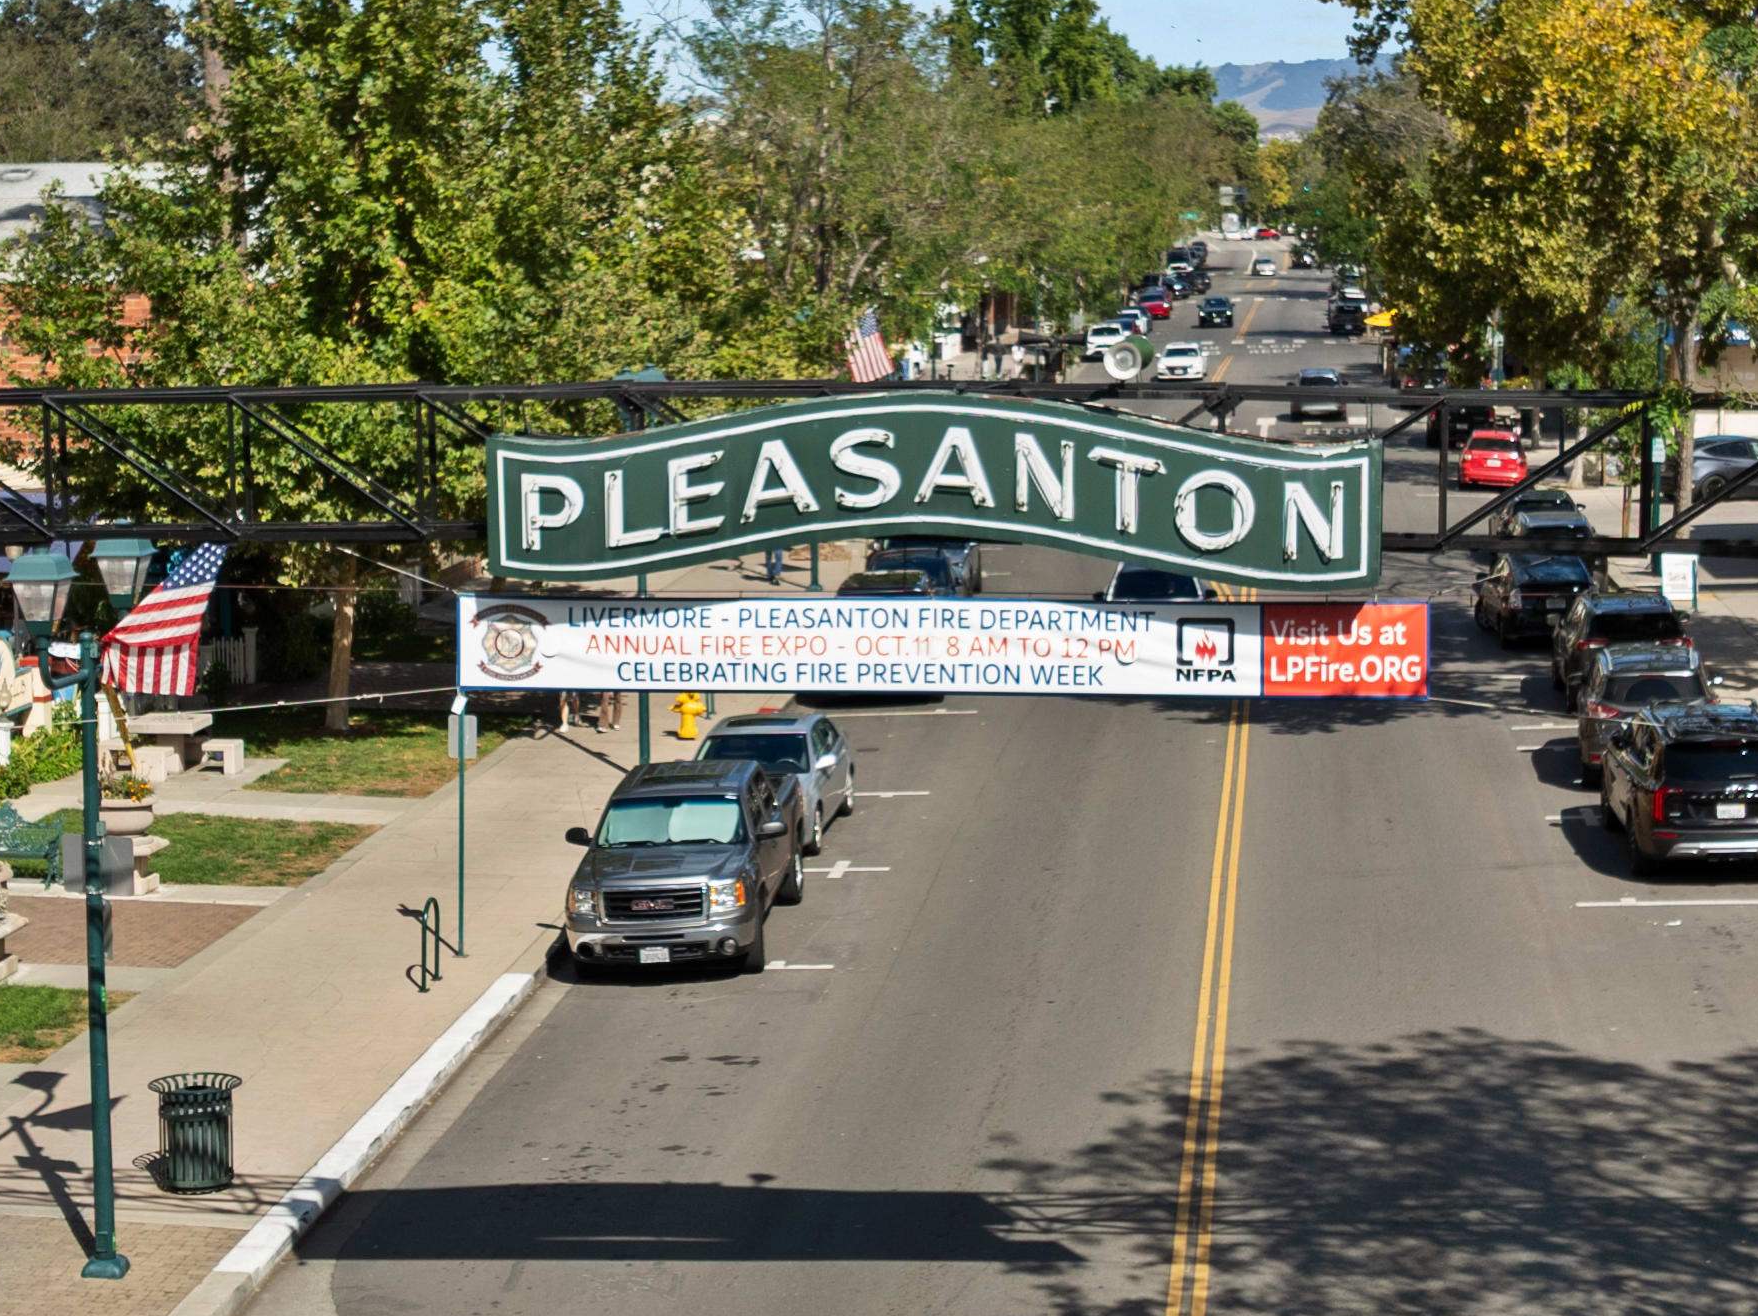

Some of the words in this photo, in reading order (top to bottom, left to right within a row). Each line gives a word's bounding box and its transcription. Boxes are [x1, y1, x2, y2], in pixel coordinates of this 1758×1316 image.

[521, 427, 1344, 560] PLEASANTON
[567, 607, 712, 629] LIVERMORE
[739, 607, 909, 629] PLEASANTON
[918, 608, 971, 630] FIRE
[980, 609, 1155, 632] DEPARTMENT
[1269, 619, 1330, 646] Visit
[1338, 620, 1373, 646] Us
[1379, 621, 1407, 645] at
[585, 634, 691, 655] ANNUAL
[701, 635, 752, 657] FIRE
[762, 635, 828, 656] EXPO
[946, 635, 961, 657] 8
[968, 636, 1008, 657] AM
[1017, 637, 1051, 658] TO
[1063, 638, 1089, 658] 12
[1098, 638, 1136, 660] PM
[617, 662, 787, 683] CELEBRATING
[797, 663, 847, 683] FIRE
[857, 664, 1021, 685] PREVENTION
[1030, 665, 1104, 686] WEEK
[1176, 669, 1236, 682] NFPA
[1269, 655, 1422, 683] LPFire.ORG
